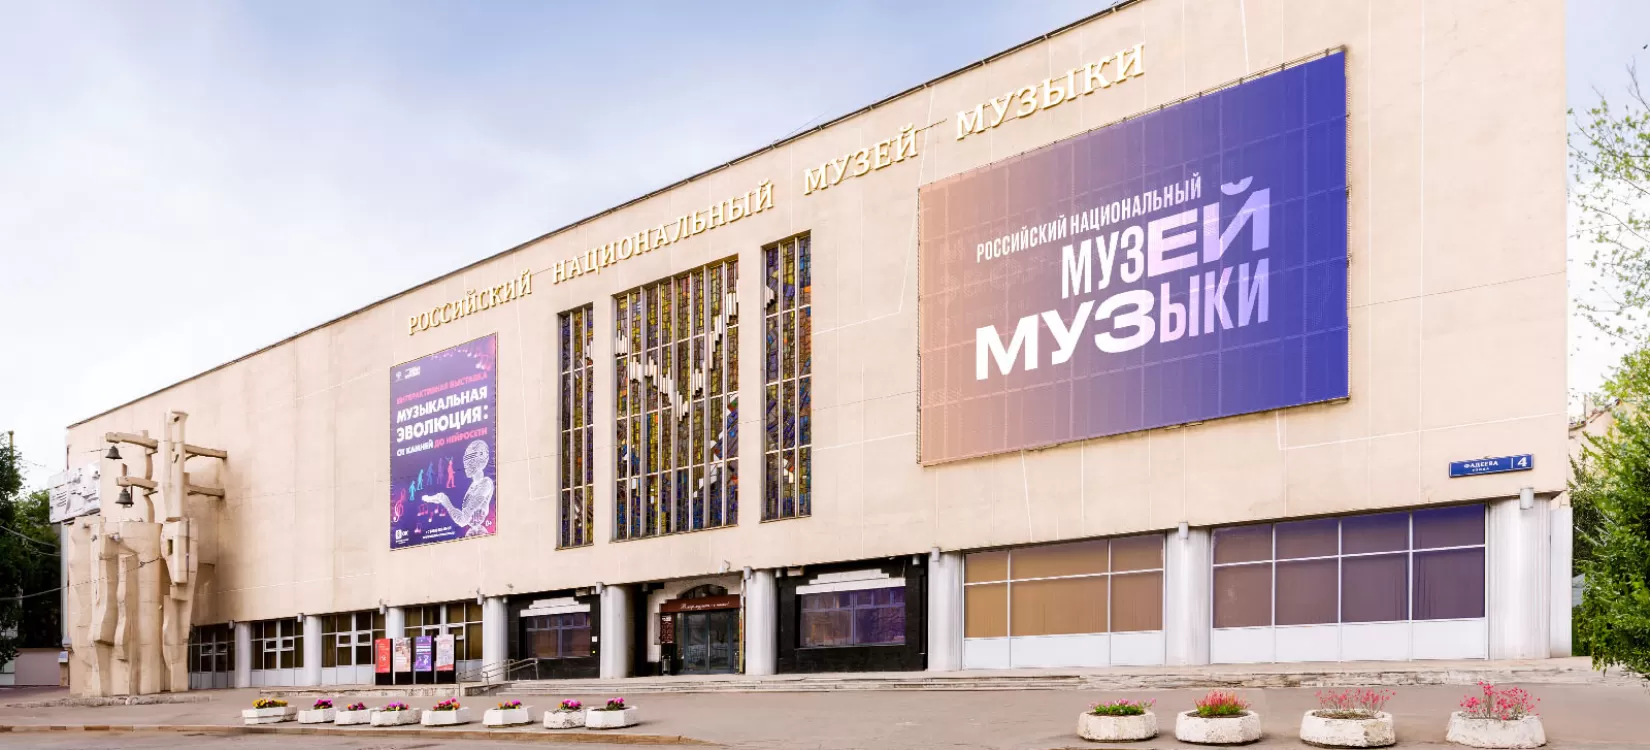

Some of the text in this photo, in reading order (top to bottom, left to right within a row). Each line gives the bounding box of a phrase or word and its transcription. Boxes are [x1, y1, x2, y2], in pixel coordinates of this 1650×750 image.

[408, 42, 1144, 335] РОССИЙСКИЙ НАЦИОНАЛЬНЫЙ МУЗЕЙ МУЗЫКИ
[976, 172, 1201, 263] РОССИЙСКИЙ НАЦИОНАЛЬНЫЙ
[1061, 176, 1270, 299] МУЗЕЙ
[976, 258, 1269, 381] МУЗЫКИ
[396, 386, 487, 424] МУЗЫКАЛЬНАЯ
[396, 405, 488, 443] ЭВОЛЮЦИЯ:
[405, 439, 433, 454] КАМНЕЙ
[434, 438, 445, 449] ДО
[446, 427, 488, 444] НЕЙРОСЕТИ
[1463, 460, 1499, 469] ФАДЕЕВА
[1517, 456, 1528, 467] 4
